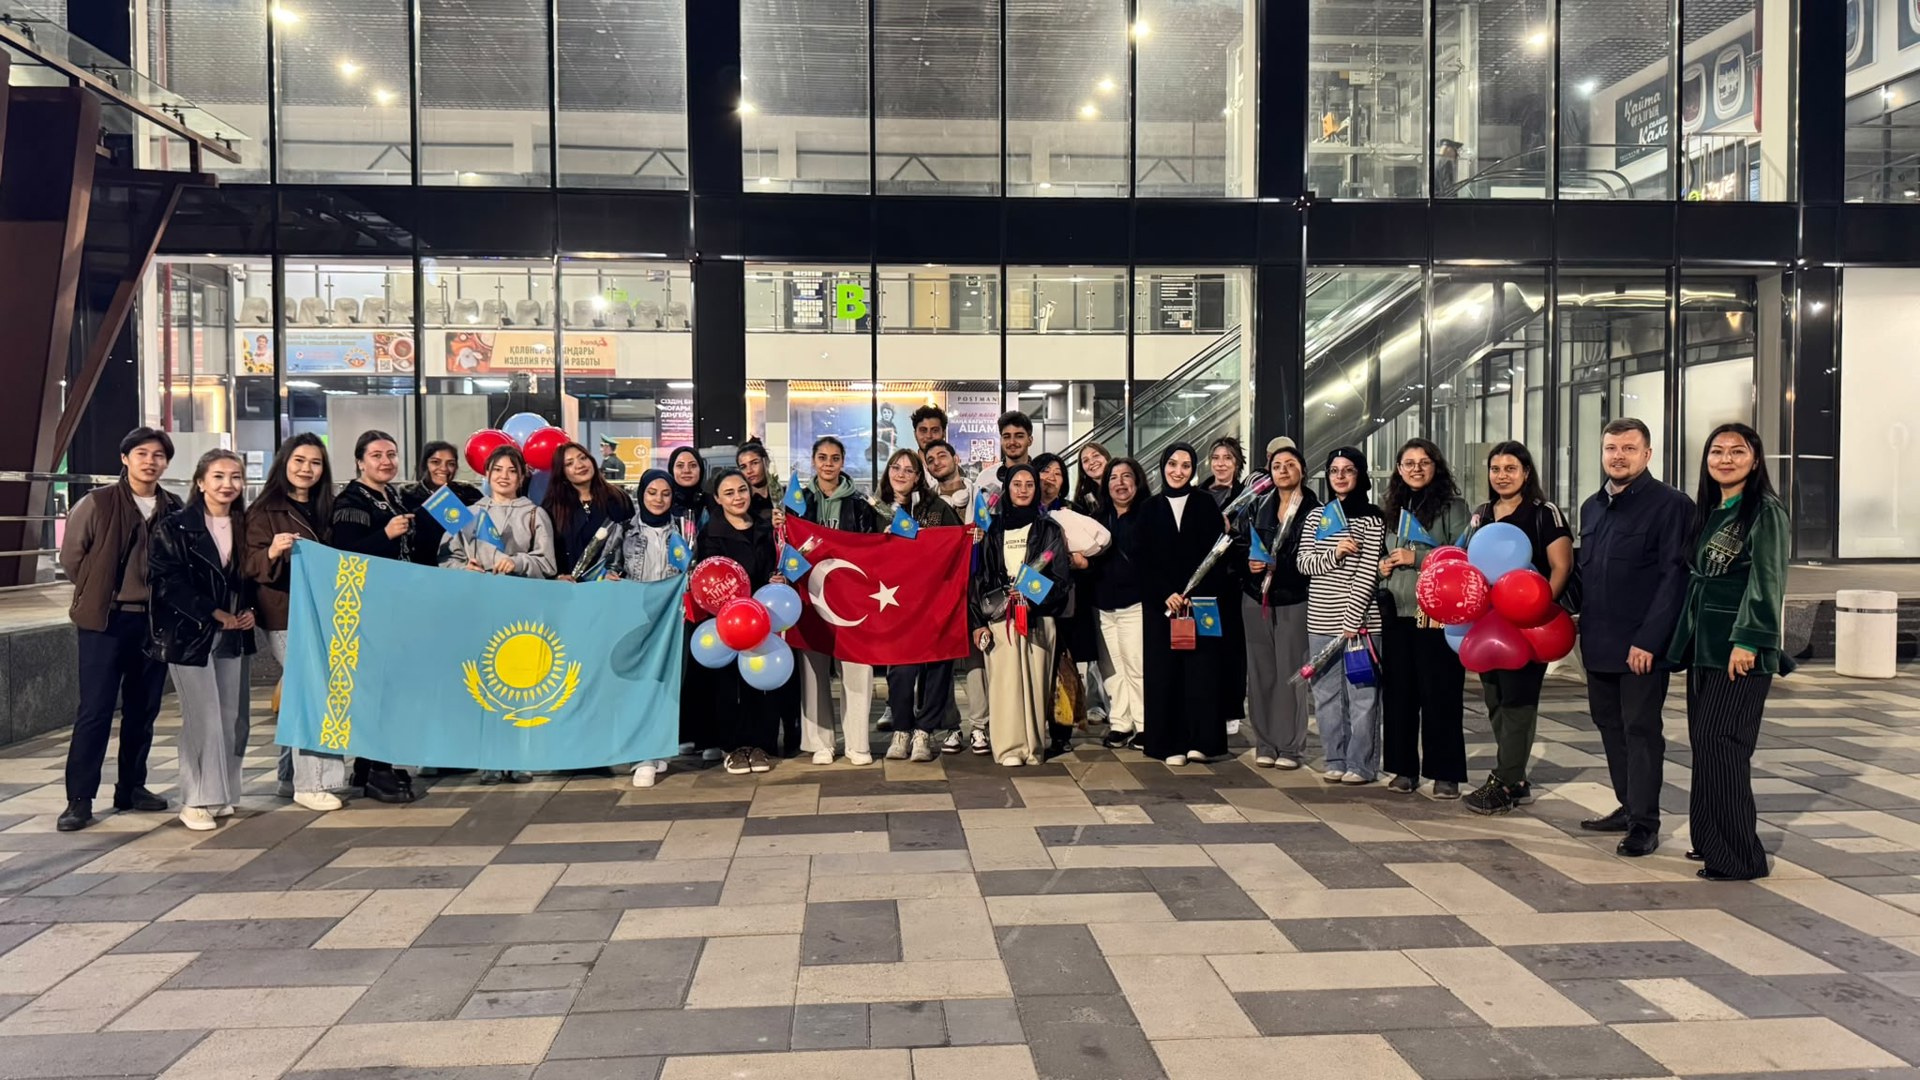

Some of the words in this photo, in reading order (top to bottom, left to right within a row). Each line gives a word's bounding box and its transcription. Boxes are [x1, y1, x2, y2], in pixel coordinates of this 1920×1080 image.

[836, 283, 867, 320] B
[504, 356, 539, 366] ИЗДЕЛИЯ
[540, 357, 569, 366] РУЧЙ
